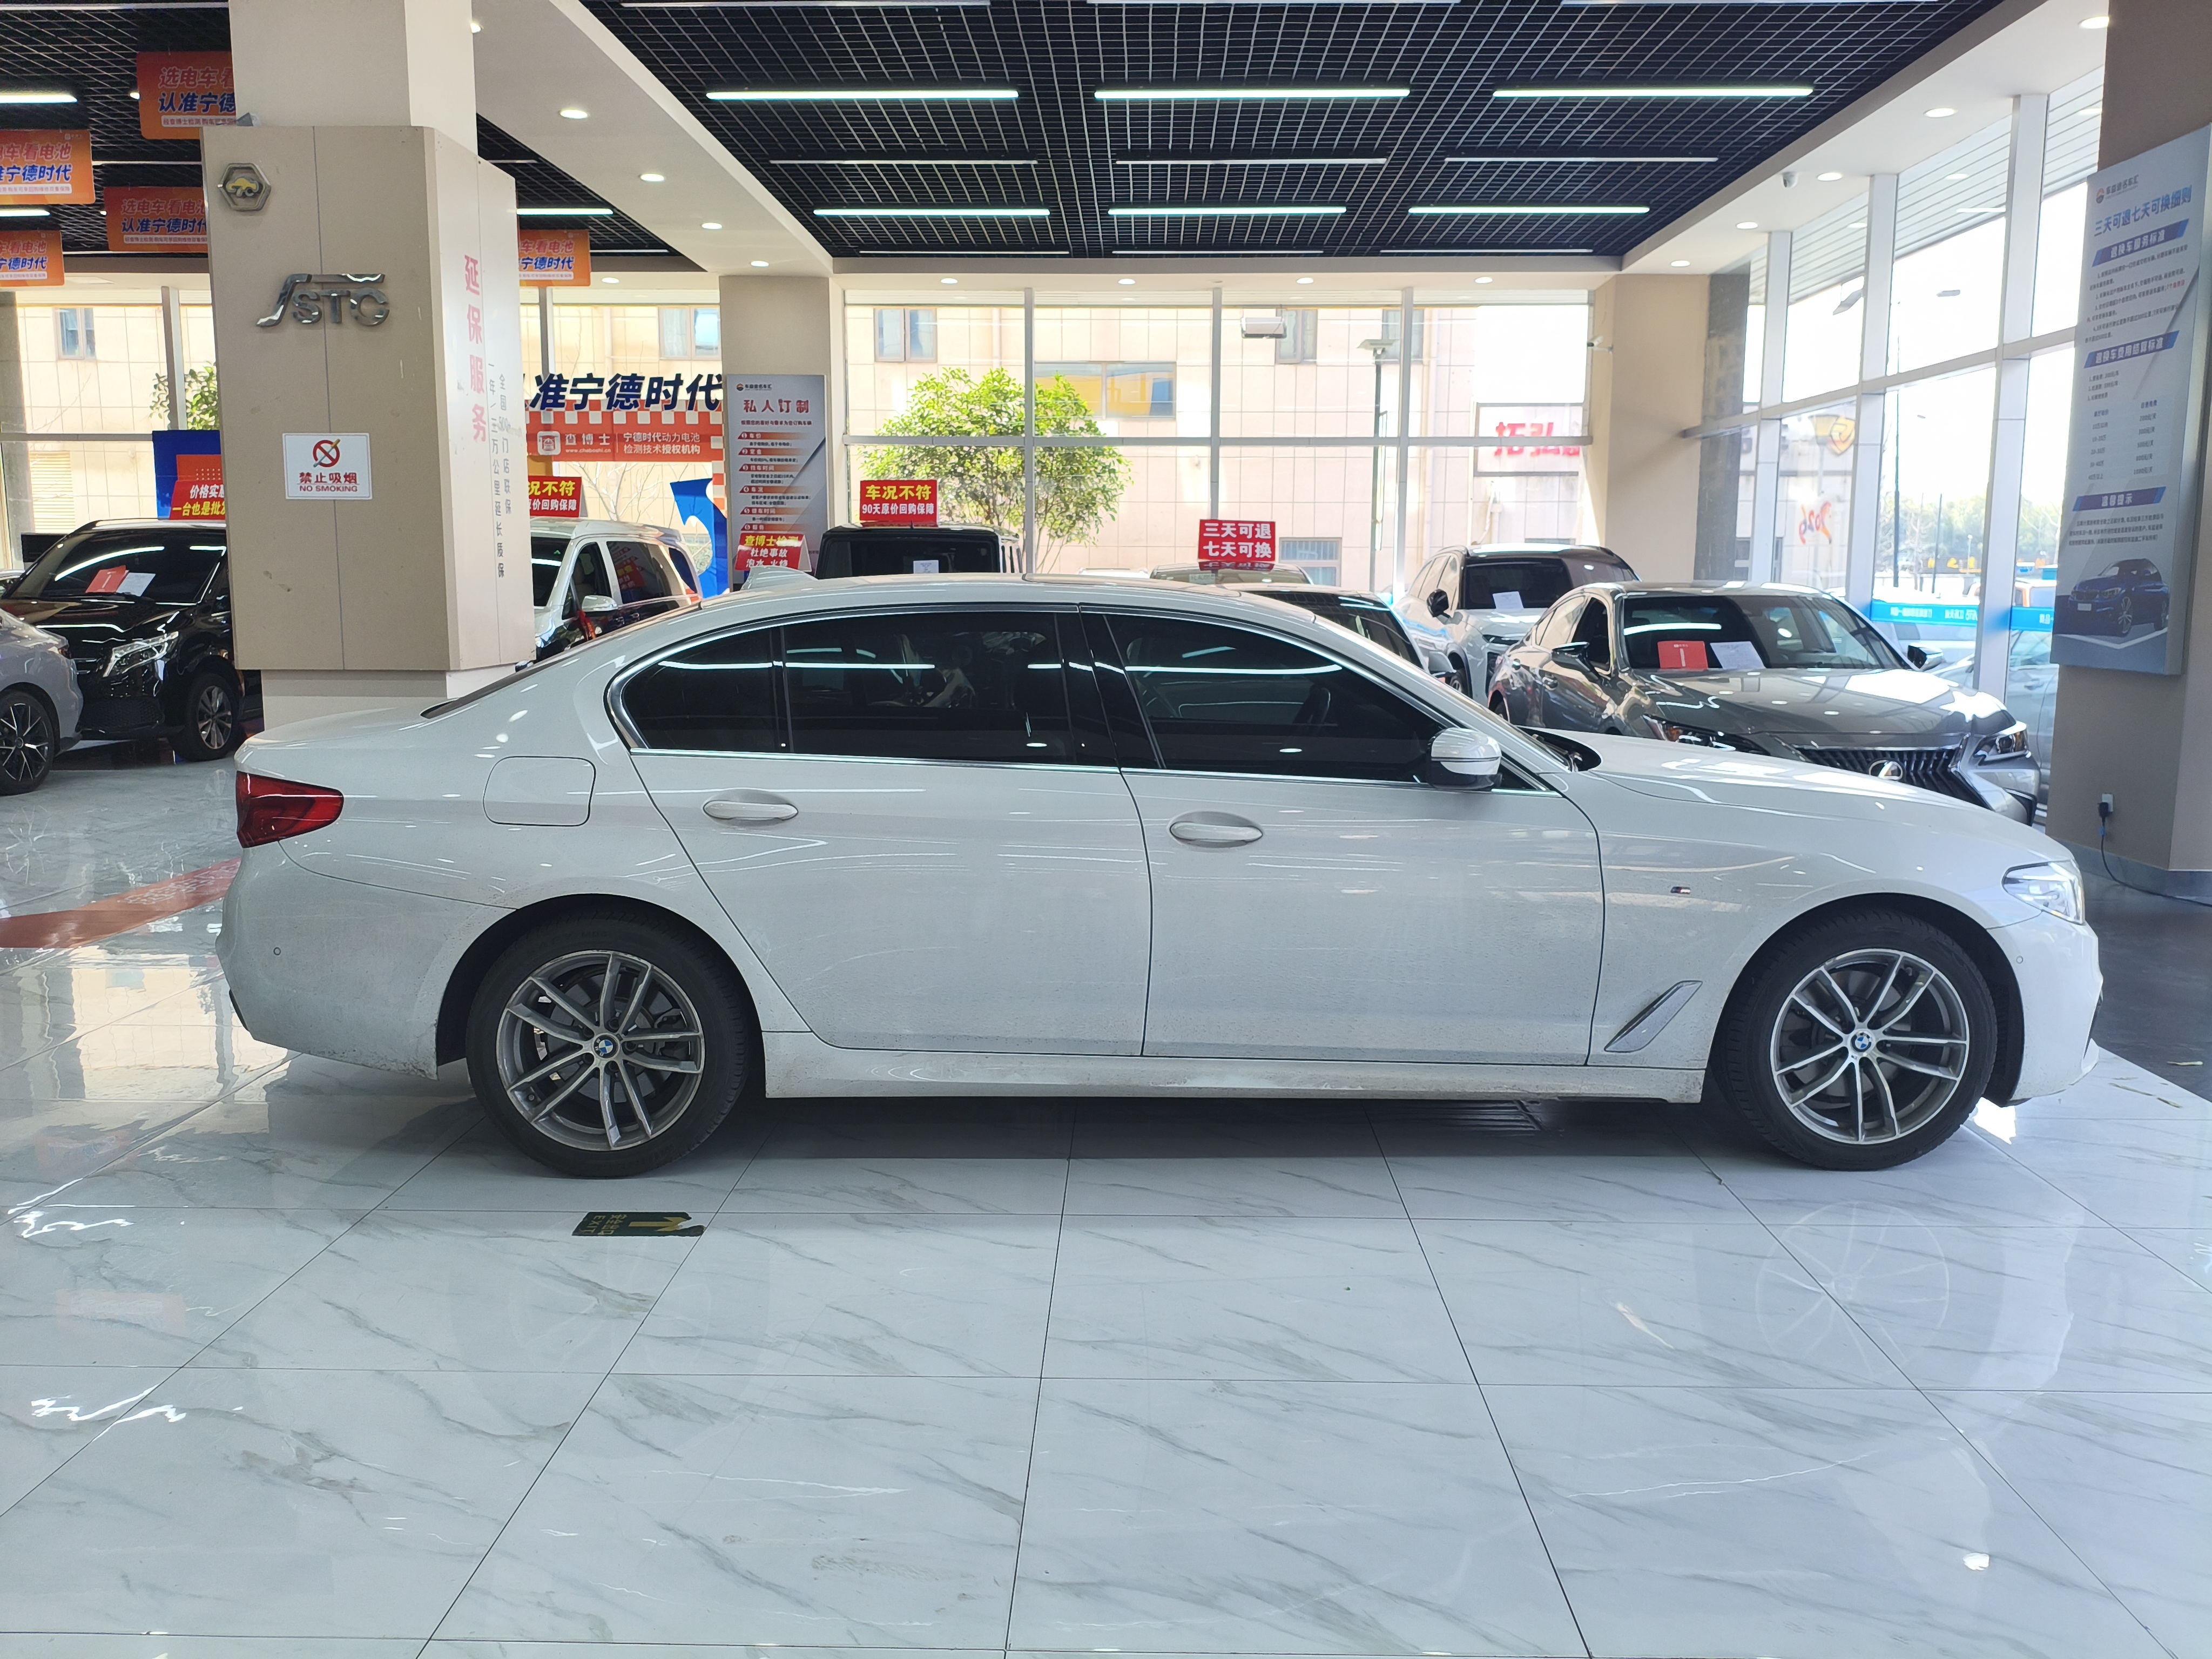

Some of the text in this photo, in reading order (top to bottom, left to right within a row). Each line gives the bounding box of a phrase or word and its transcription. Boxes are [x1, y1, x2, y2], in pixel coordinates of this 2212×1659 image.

[159, 66, 218, 89] 选电车
[159, 92, 236, 113] 认准宁德
[23, 143, 72, 161] 看电池
[122, 198, 166, 215] 选电车
[2093, 184, 2193, 237] 三天可退七天可换细则
[9, 240, 47, 255] 看电池
[535, 239, 574, 255] 看电池
[518, 256, 575, 271] 宁德时代
[464, 255, 486, 442] 延保服务
[523, 373, 723, 411] 准宁德时代
[743, 399, 809, 413] 私人订制
[565, 433, 610, 446] 查博士
[623, 432, 700, 443] 宁德时代动力电池
[623, 444, 700, 455] 检测技术授权机构
[299, 472, 357, 484] 禁止吸烟
[865, 484, 932, 501] 车况不符
[529, 498, 577, 511] 价回购保障
[862, 503, 935, 515] 90天原价回购保障
[1203, 522, 1272, 539] 三天可退
[750, 548, 788, 558] 杜绝事故
[1203, 541, 1272, 558] 七天可换
[581, 1215, 606, 1234] EXIT
